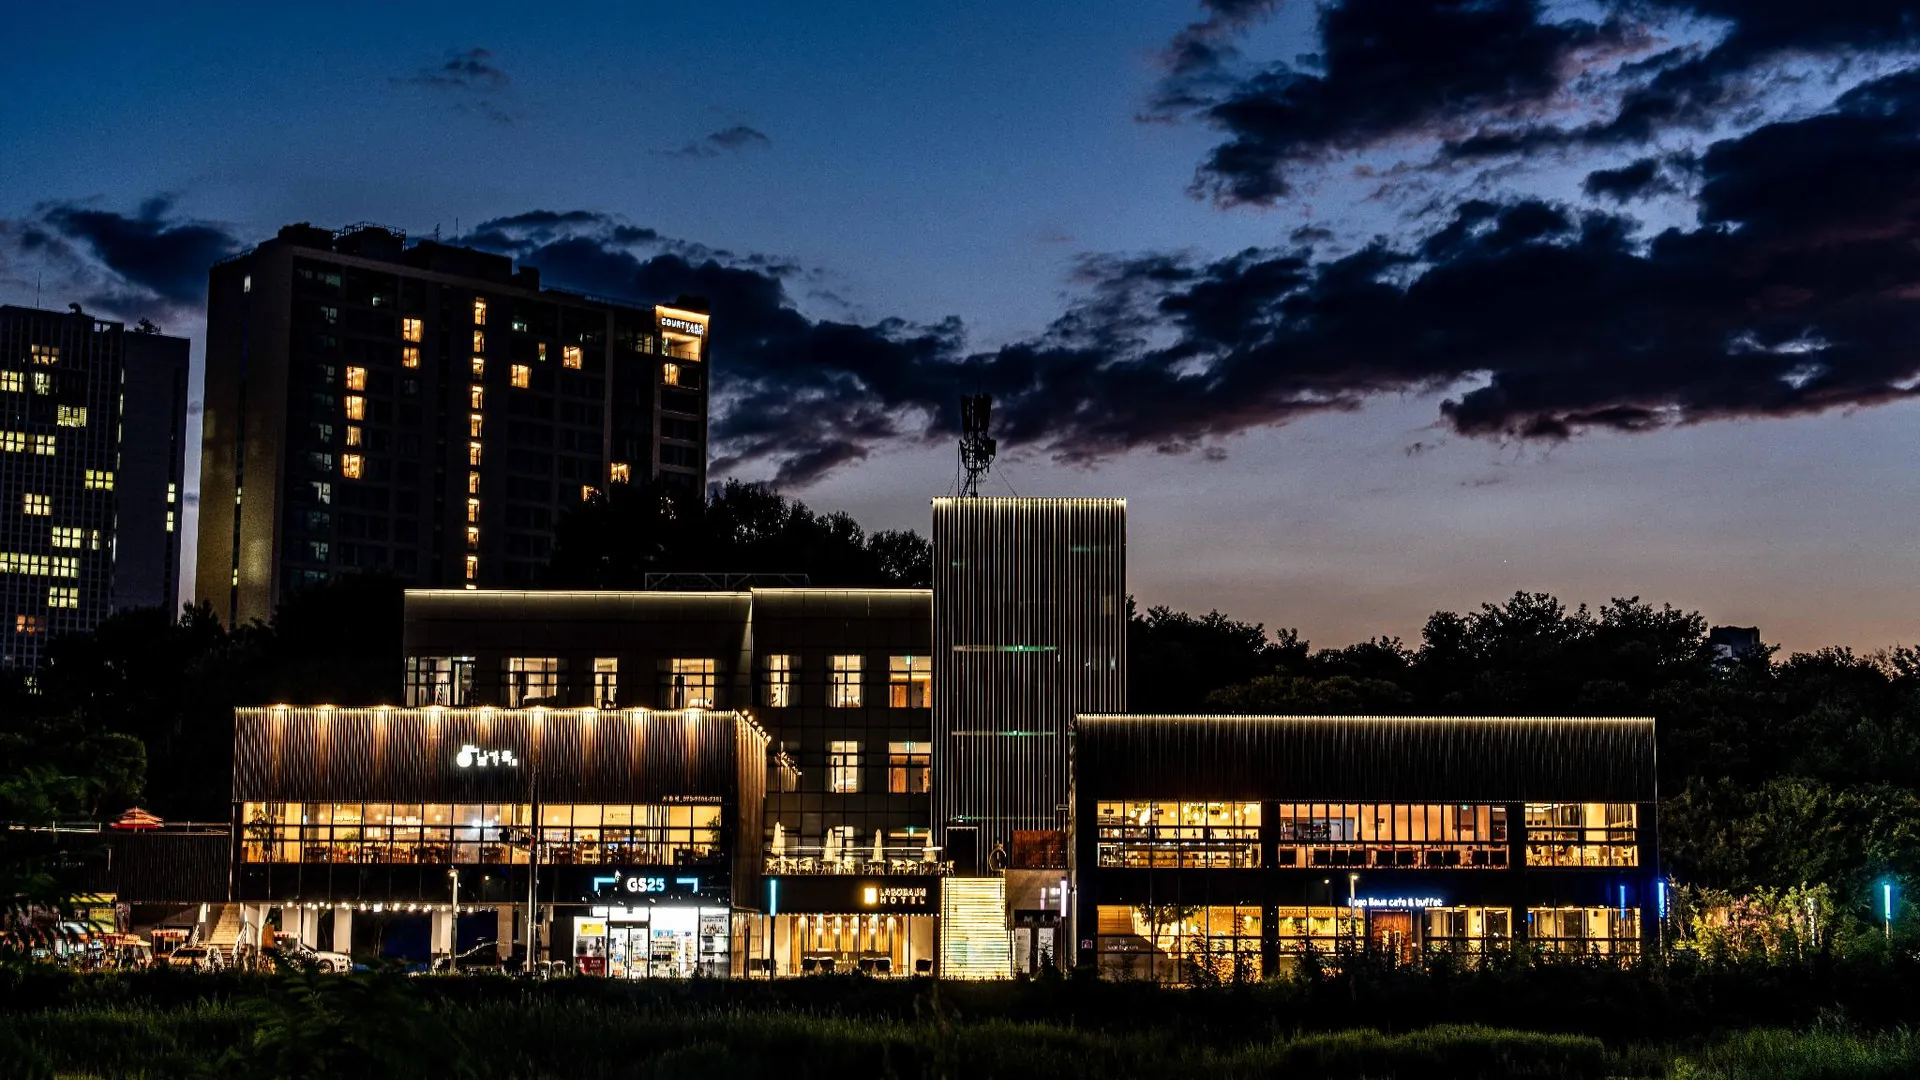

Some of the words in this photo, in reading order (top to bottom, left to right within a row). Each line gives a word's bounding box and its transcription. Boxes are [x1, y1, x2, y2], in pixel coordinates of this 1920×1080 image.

[626, 877, 665, 892] GS25
[880, 896, 925, 904] HOTEL
[1415, 897, 1443, 907] buffet
